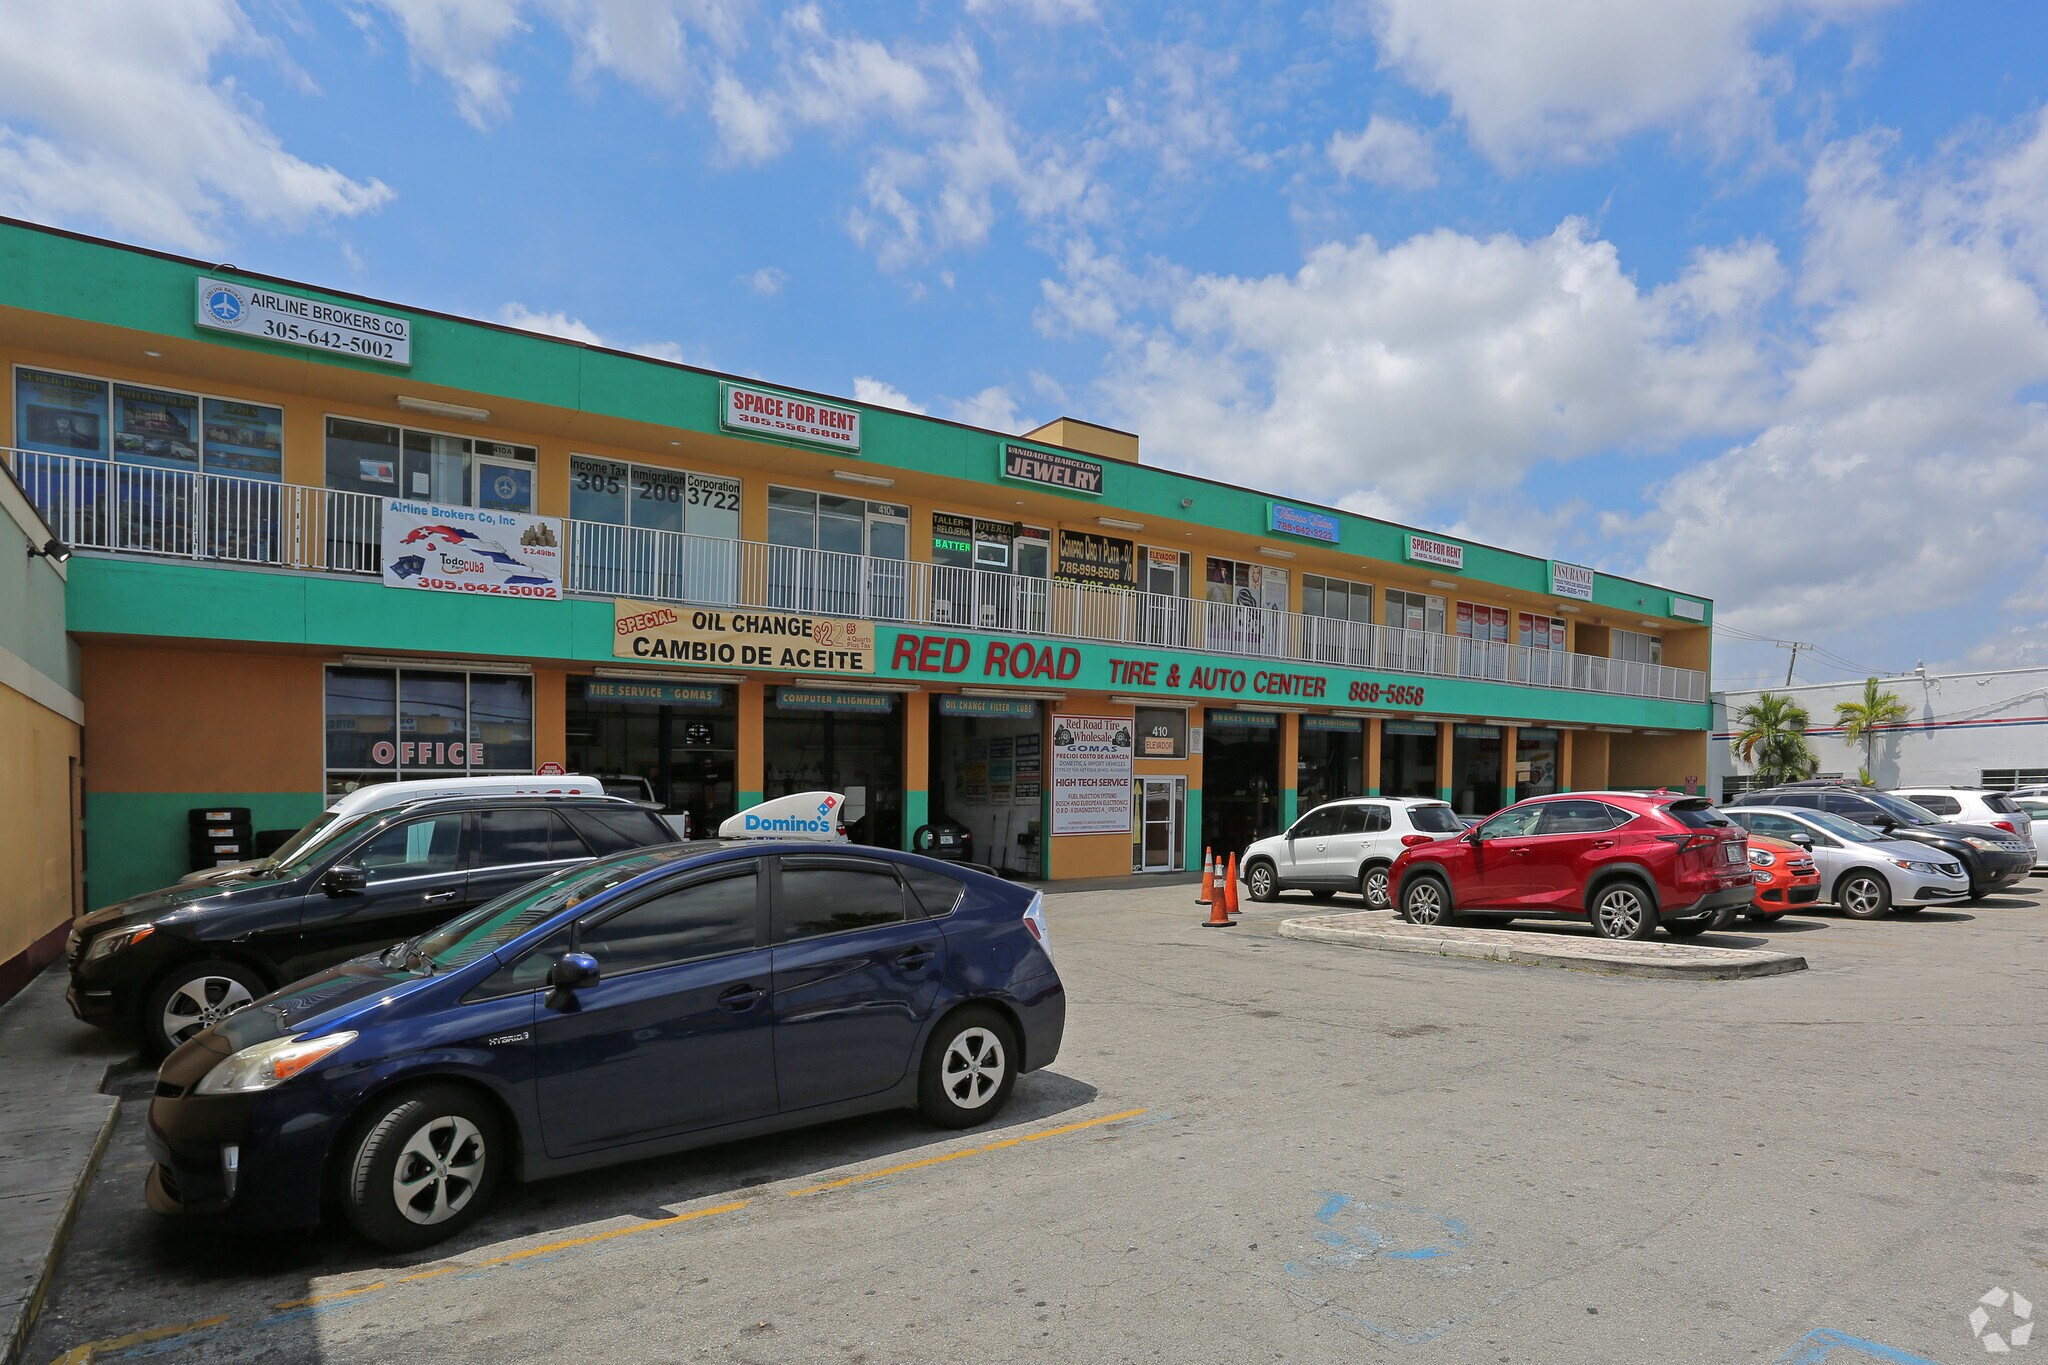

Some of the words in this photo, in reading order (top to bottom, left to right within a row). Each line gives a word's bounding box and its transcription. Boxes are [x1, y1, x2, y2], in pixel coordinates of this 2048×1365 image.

[250, 292, 308, 316] AIRLINE
[312, 304, 380, 331] BROKERS
[384, 320, 407, 337] CO.
[264, 319, 393, 359] 305-642-5002
[734, 391, 783, 418] SPACE
[787, 402, 815, 424] FOR
[819, 408, 856, 432] RENT
[738, 414, 850, 441] 305.556.6808
[1008, 446, 1054, 462] VANIDADES
[1054, 456, 1100, 472] BARCELONA
[570, 457, 608, 474] Income
[610, 464, 628, 478] Tax
[631, 467, 686, 485] Inmigration
[688, 475, 740, 494] Corporation
[1007, 457, 1100, 490] JEWELRY
[576, 472, 620, 495] 305
[639, 481, 680, 504] 200
[688, 487, 740, 512] 3722
[390, 501, 428, 516] Airline
[432, 506, 475, 521] Brokers
[478, 512, 496, 526] Co,
[499, 514, 516, 526] Inc
[934, 515, 964, 527] TALLER
[937, 524, 970, 537] RELOJERIA
[975, 521, 1012, 535] JOYERIA
[1150, 552, 1176, 562] ELEVADOR
[1412, 538, 1432, 554] SPACE
[1434, 542, 1445, 556] FOR
[1446, 545, 1462, 559] RENT
[440, 553, 464, 566] Todo
[1060, 560, 1120, 580] 786-999-6506
[1554, 564, 1592, 585] INSURANCE
[418, 577, 557, 598] 305.642.5002
[617, 608, 678, 636] SPECIAL
[692, 611, 726, 632] OIL
[732, 614, 813, 638] CHANGE
[632, 636, 736, 663] CAMBIO
[742, 646, 772, 666] DE
[780, 648, 863, 670] ACEITE
[891, 633, 972, 674] RED
[984, 641, 1082, 681] ROAD
[590, 684, 614, 696] TIRE
[1109, 658, 1159, 686] TIRE
[1166, 662, 1180, 688] &
[1189, 666, 1247, 693] AUTO
[1253, 670, 1327, 698] CENTER
[1348, 680, 1425, 706] 888-5858
[783, 694, 832, 704] COMPUTER
[836, 696, 886, 706] ALIGNMENT
[946, 700, 956, 710] OIL
[960, 701, 986, 711] CHANGE
[990, 702, 1010, 712] FILTER
[1016, 704, 1032, 713] LUBE
[1066, 719, 1080, 729] Red
[1083, 720, 1102, 730] Road
[1104, 720, 1120, 730] Tire
[1212, 714, 1242, 722] BRAKES
[1247, 716, 1275, 724] FRENOS
[1318, 719, 1360, 728] CONDITIONING
[1074, 731, 1112, 742] Wholesale
[1152, 726, 1168, 736] 410
[372, 741, 484, 765] OFFICE
[1146, 741, 1172, 750] ELEVADOR
[1056, 778, 1076, 786] HIGH
[1078, 778, 1097, 786] TECH
[1098, 778, 1128, 787] SERVICE
[746, 815, 830, 832] Domino's
